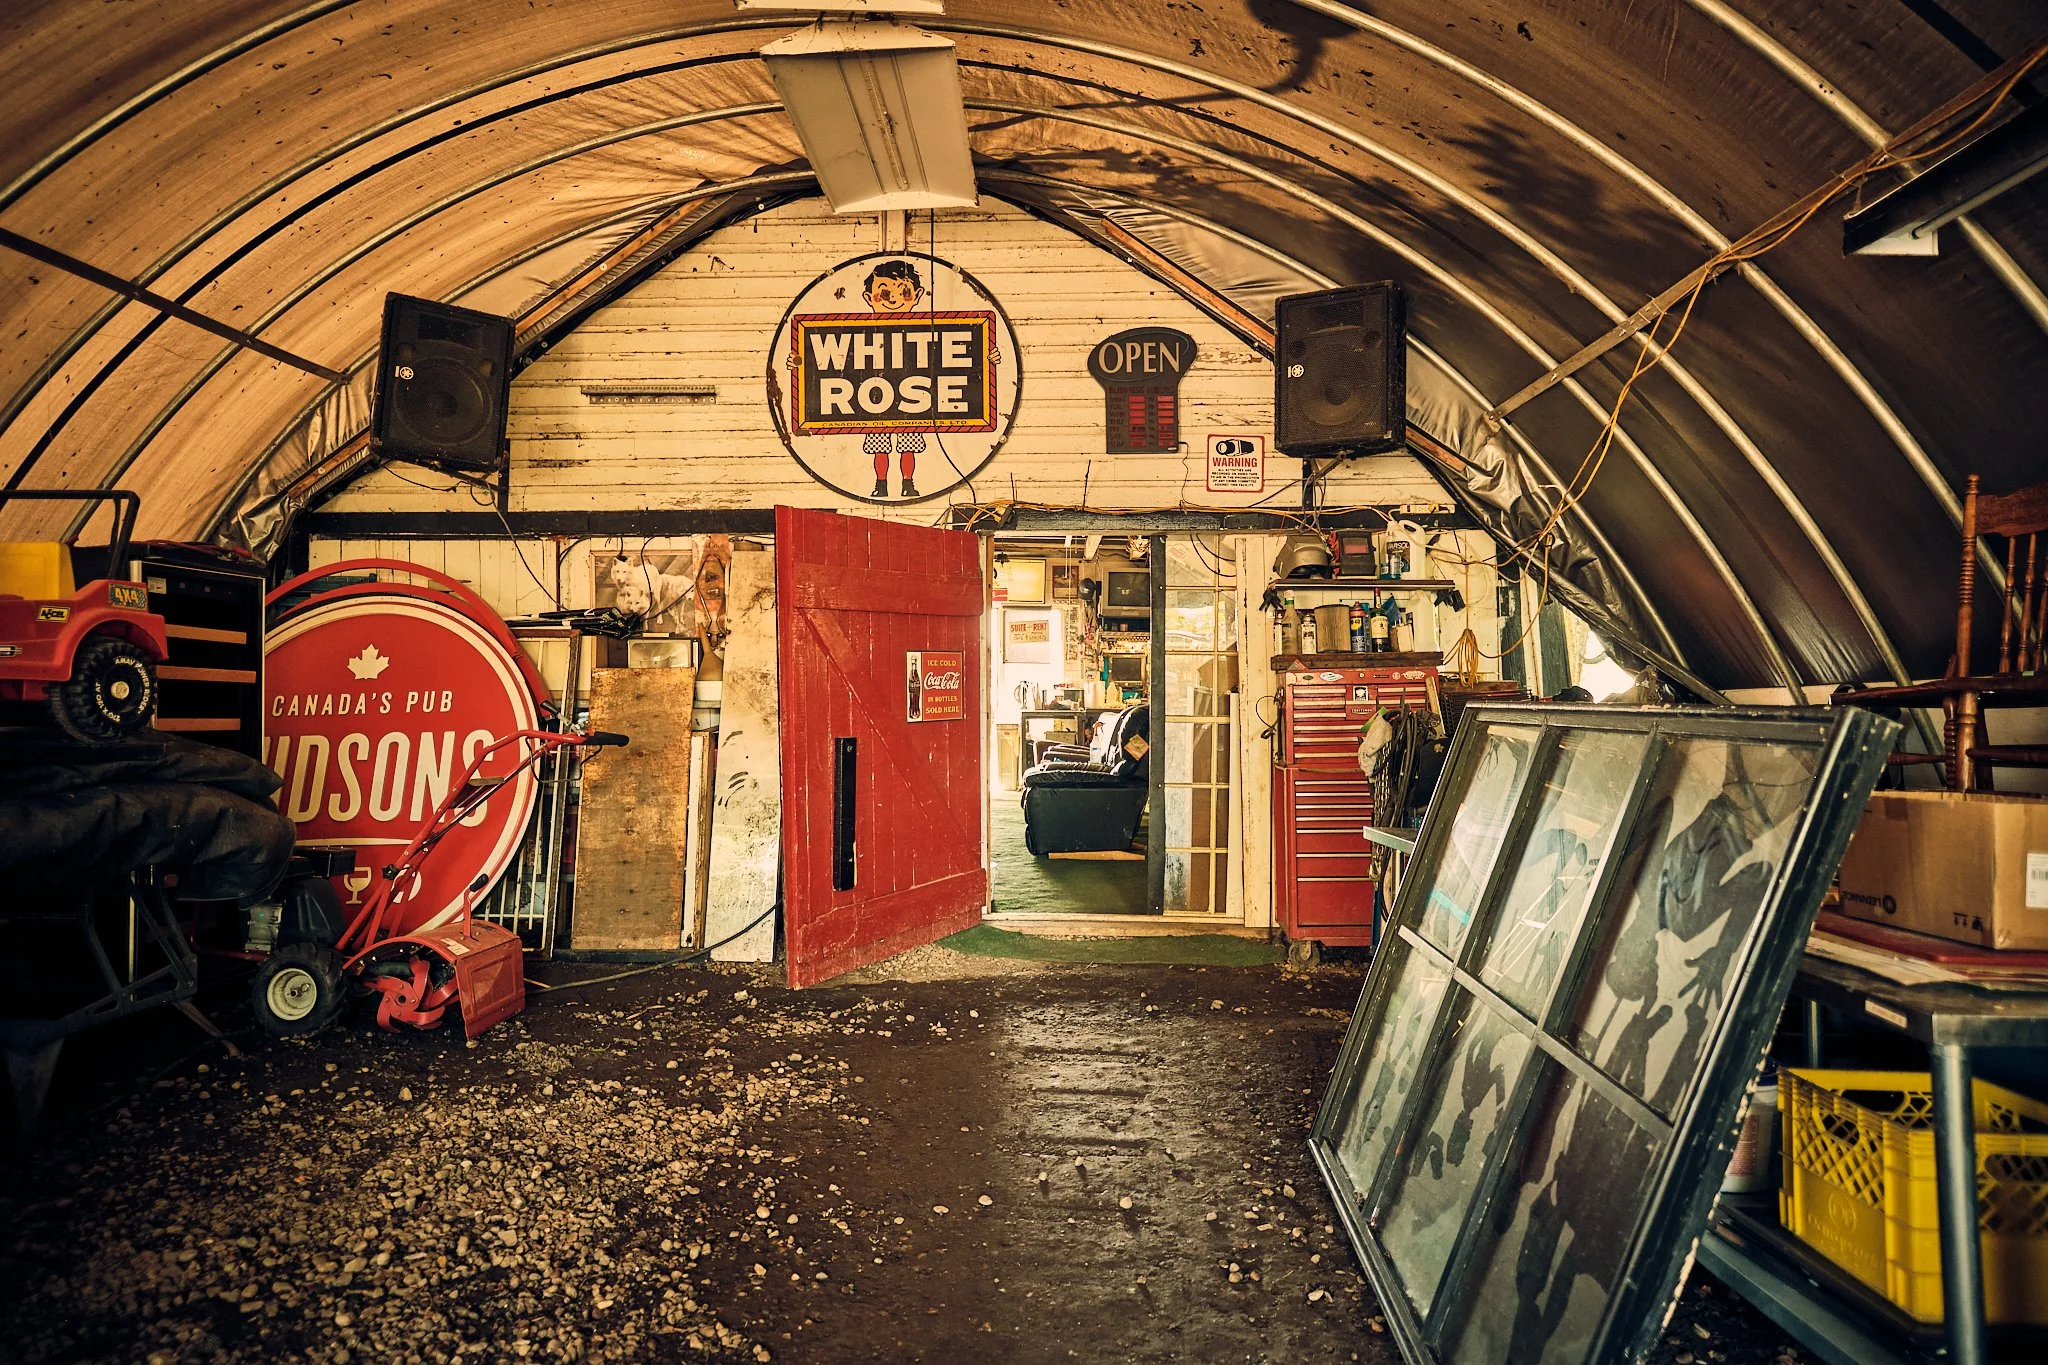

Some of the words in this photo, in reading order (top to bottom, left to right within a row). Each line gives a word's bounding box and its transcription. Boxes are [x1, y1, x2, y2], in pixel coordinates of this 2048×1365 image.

[809, 331, 973, 371] WHITE
[1098, 342, 1180, 374] OPEN
[820, 375, 969, 416] ROSE
[1212, 457, 1258, 467] WARNING
[114, 587, 139, 604] 4X4
[1010, 624, 1026, 632] SUITE
[134, 662, 150, 688] POWER
[272, 692, 392, 716] CANADA'S
[406, 690, 454, 713] PUB
